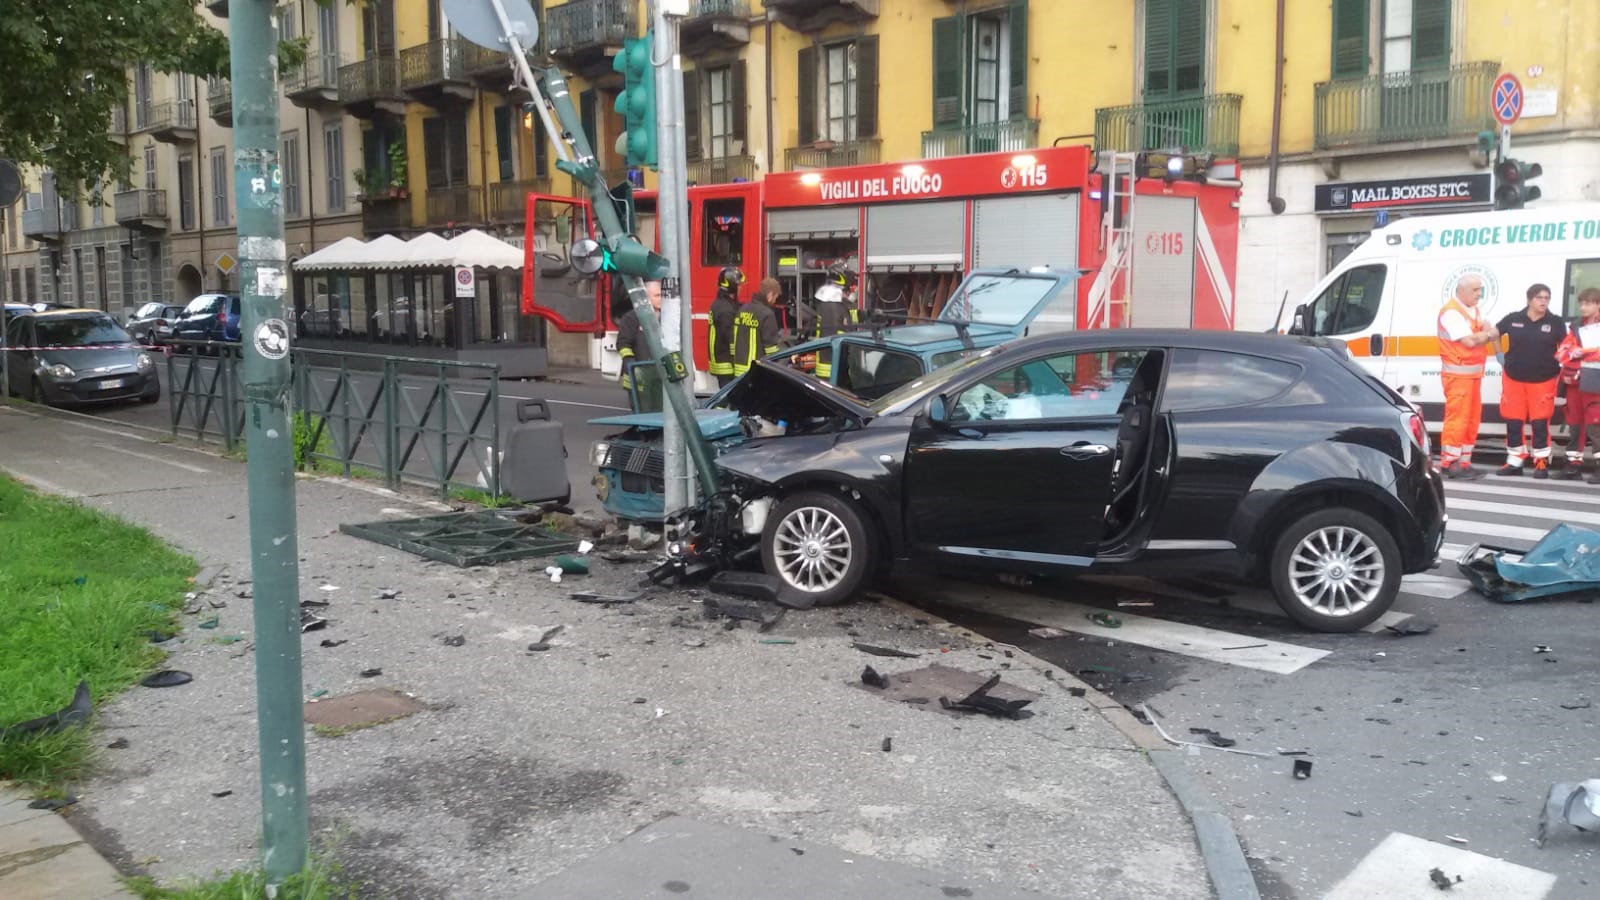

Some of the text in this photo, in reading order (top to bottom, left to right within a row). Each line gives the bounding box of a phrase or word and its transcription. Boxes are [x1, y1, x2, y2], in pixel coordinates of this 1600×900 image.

[820, 174, 942, 199] VIGILI DEL FUOCO
[1019, 165, 1047, 187] 115
[1351, 187, 1390, 203] MAIL
[1392, 184, 1438, 200] BOXES
[1438, 182, 1470, 197] ETC.
[1160, 231, 1184, 255] 115
[1440, 226, 1502, 248] CROCE
[1506, 222, 1568, 243] VERDE
